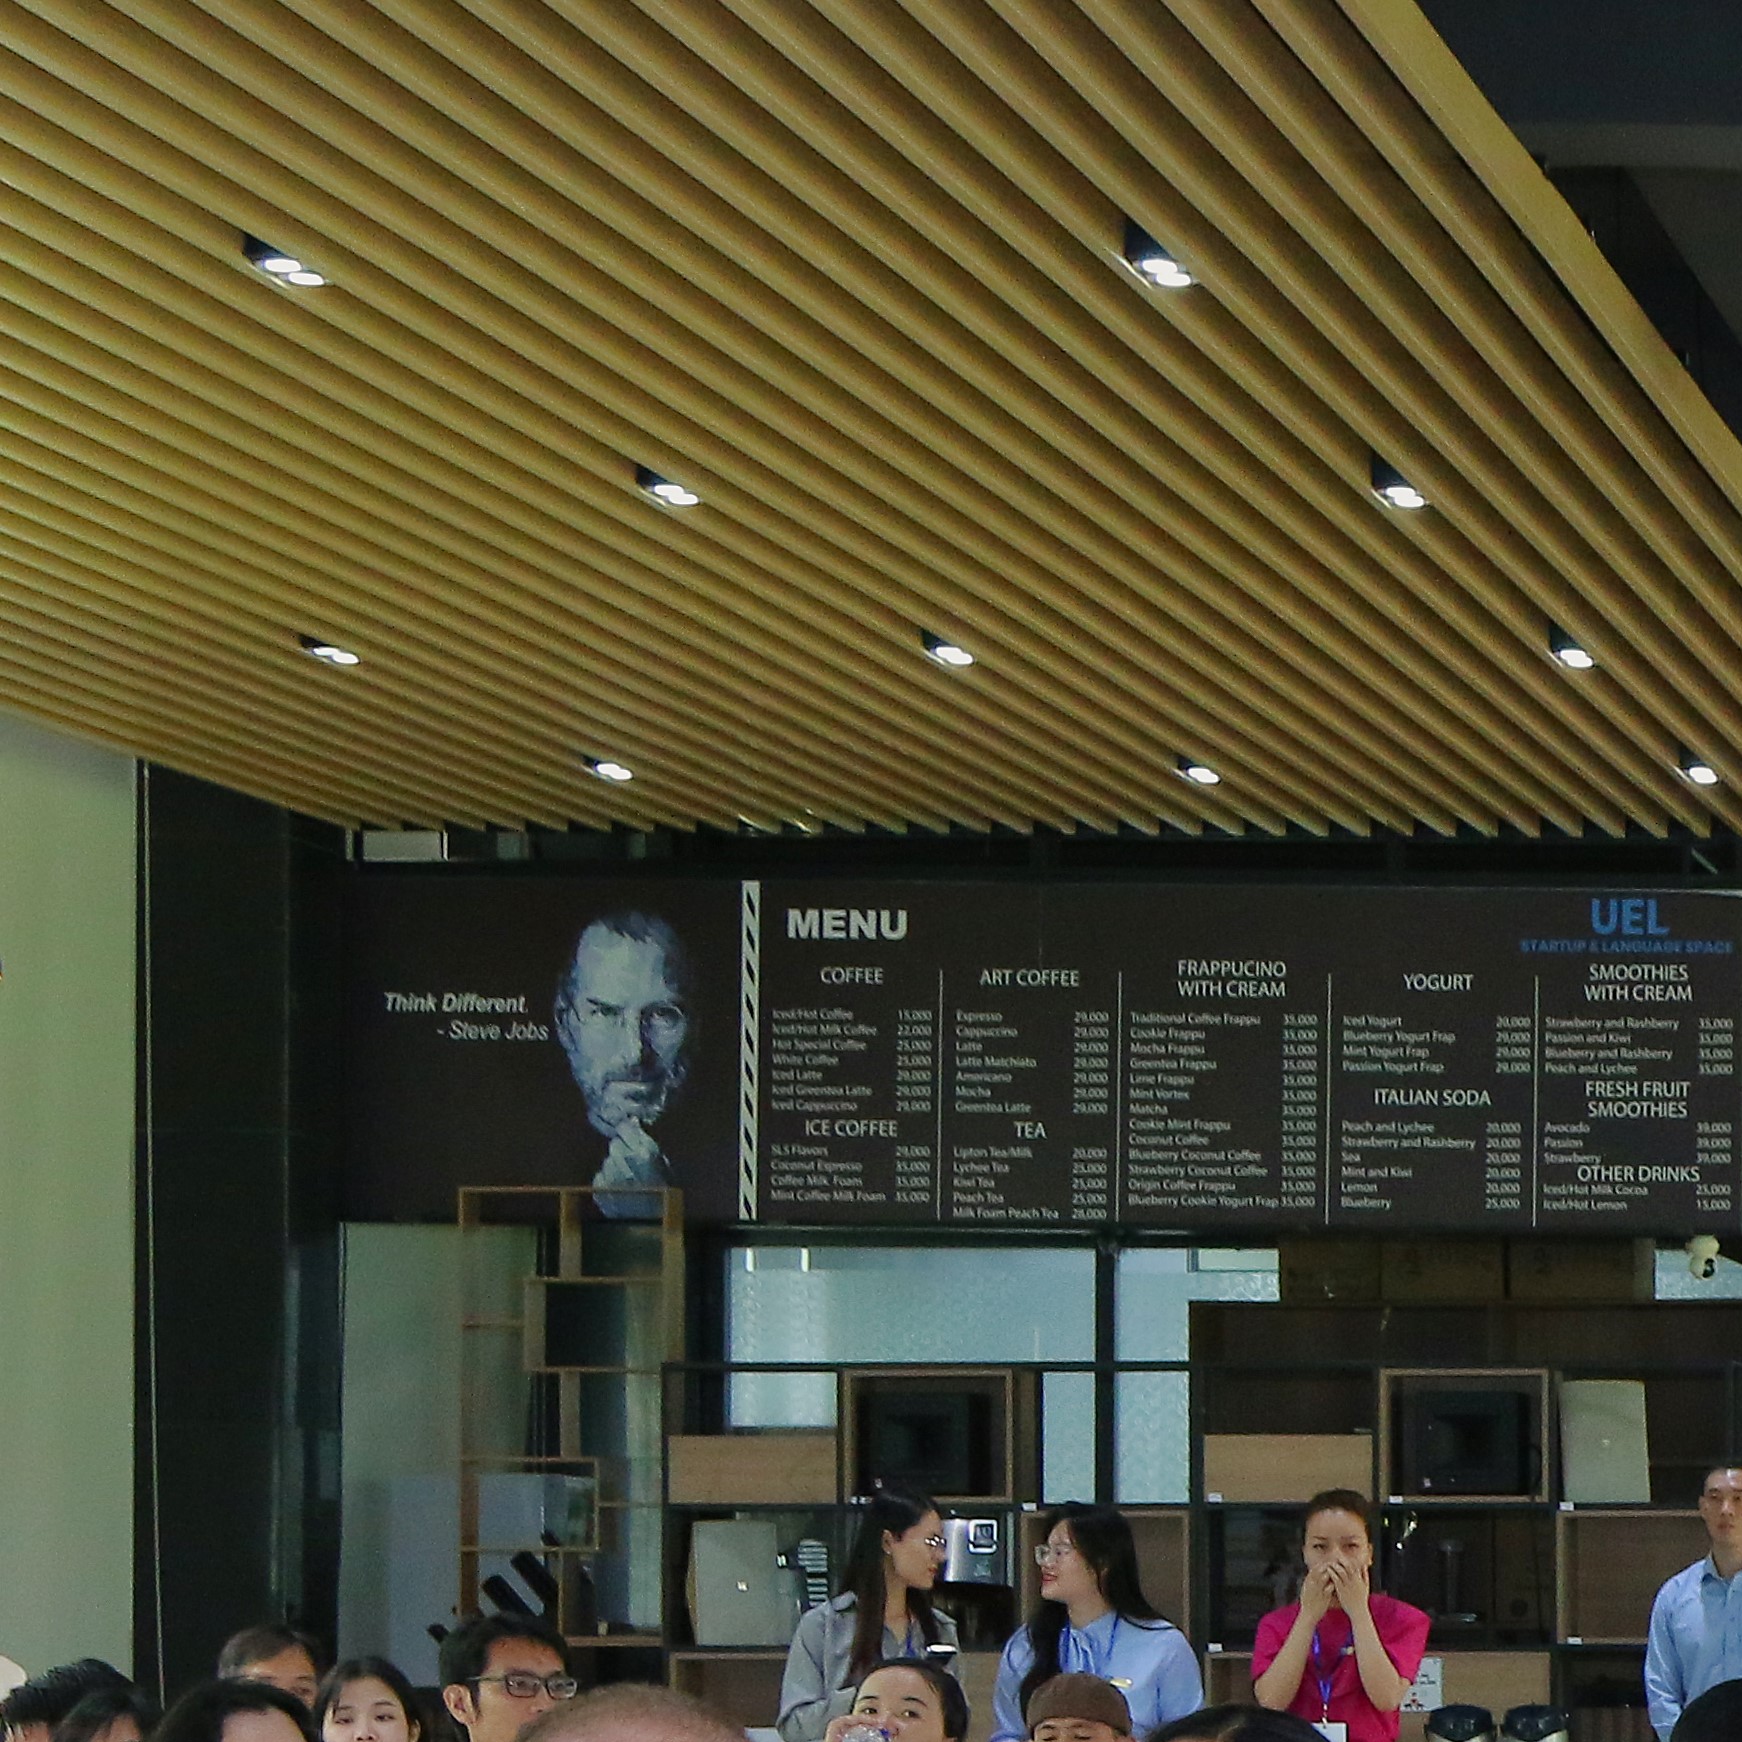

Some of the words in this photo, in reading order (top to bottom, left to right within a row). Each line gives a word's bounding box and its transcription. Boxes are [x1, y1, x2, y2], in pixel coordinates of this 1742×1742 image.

[788, 908, 907, 940] MENU
[1592, 898, 1670, 935] UEL
[1521, 940, 1587, 953] STARTUP
[1602, 940, 1682, 953] LANGUAGE
[1686, 941, 1733, 953] SPACE
[820, 967, 884, 985] COFFEE
[1178, 960, 1286, 977] FRAPPUCINO
[1589, 963, 1689, 981] SMOOTHIES
[979, 969, 1013, 986] ART
[1017, 969, 1080, 987] COFFEE
[1403, 974, 1474, 991] YOGURT
[1178, 981, 1221, 996] WITH
[1226, 981, 1286, 998] CREAM
[1584, 984, 1629, 1001] WITH
[1633, 984, 1693, 1001] CREAM
[384, 992, 437, 1012] Think
[449, 1020, 500, 1040] Steve
[505, 1021, 549, 1040] Jobs
[1374, 1088, 1438, 1106] ITALIAN
[1443, 1089, 1491, 1106] SODA
[1585, 1081, 1638, 1097] FRESH
[1643, 1081, 1690, 1097] FRUIT
[1588, 1101, 1688, 1118] SMOOTHIES
[805, 1119, 830, 1136] ICE
[835, 1119, 898, 1137] COFFEE
[1014, 1122, 1047, 1139] TEA
[1577, 1166, 1634, 1182] OTHER
[1638, 1166, 1700, 1182] DRINKS
